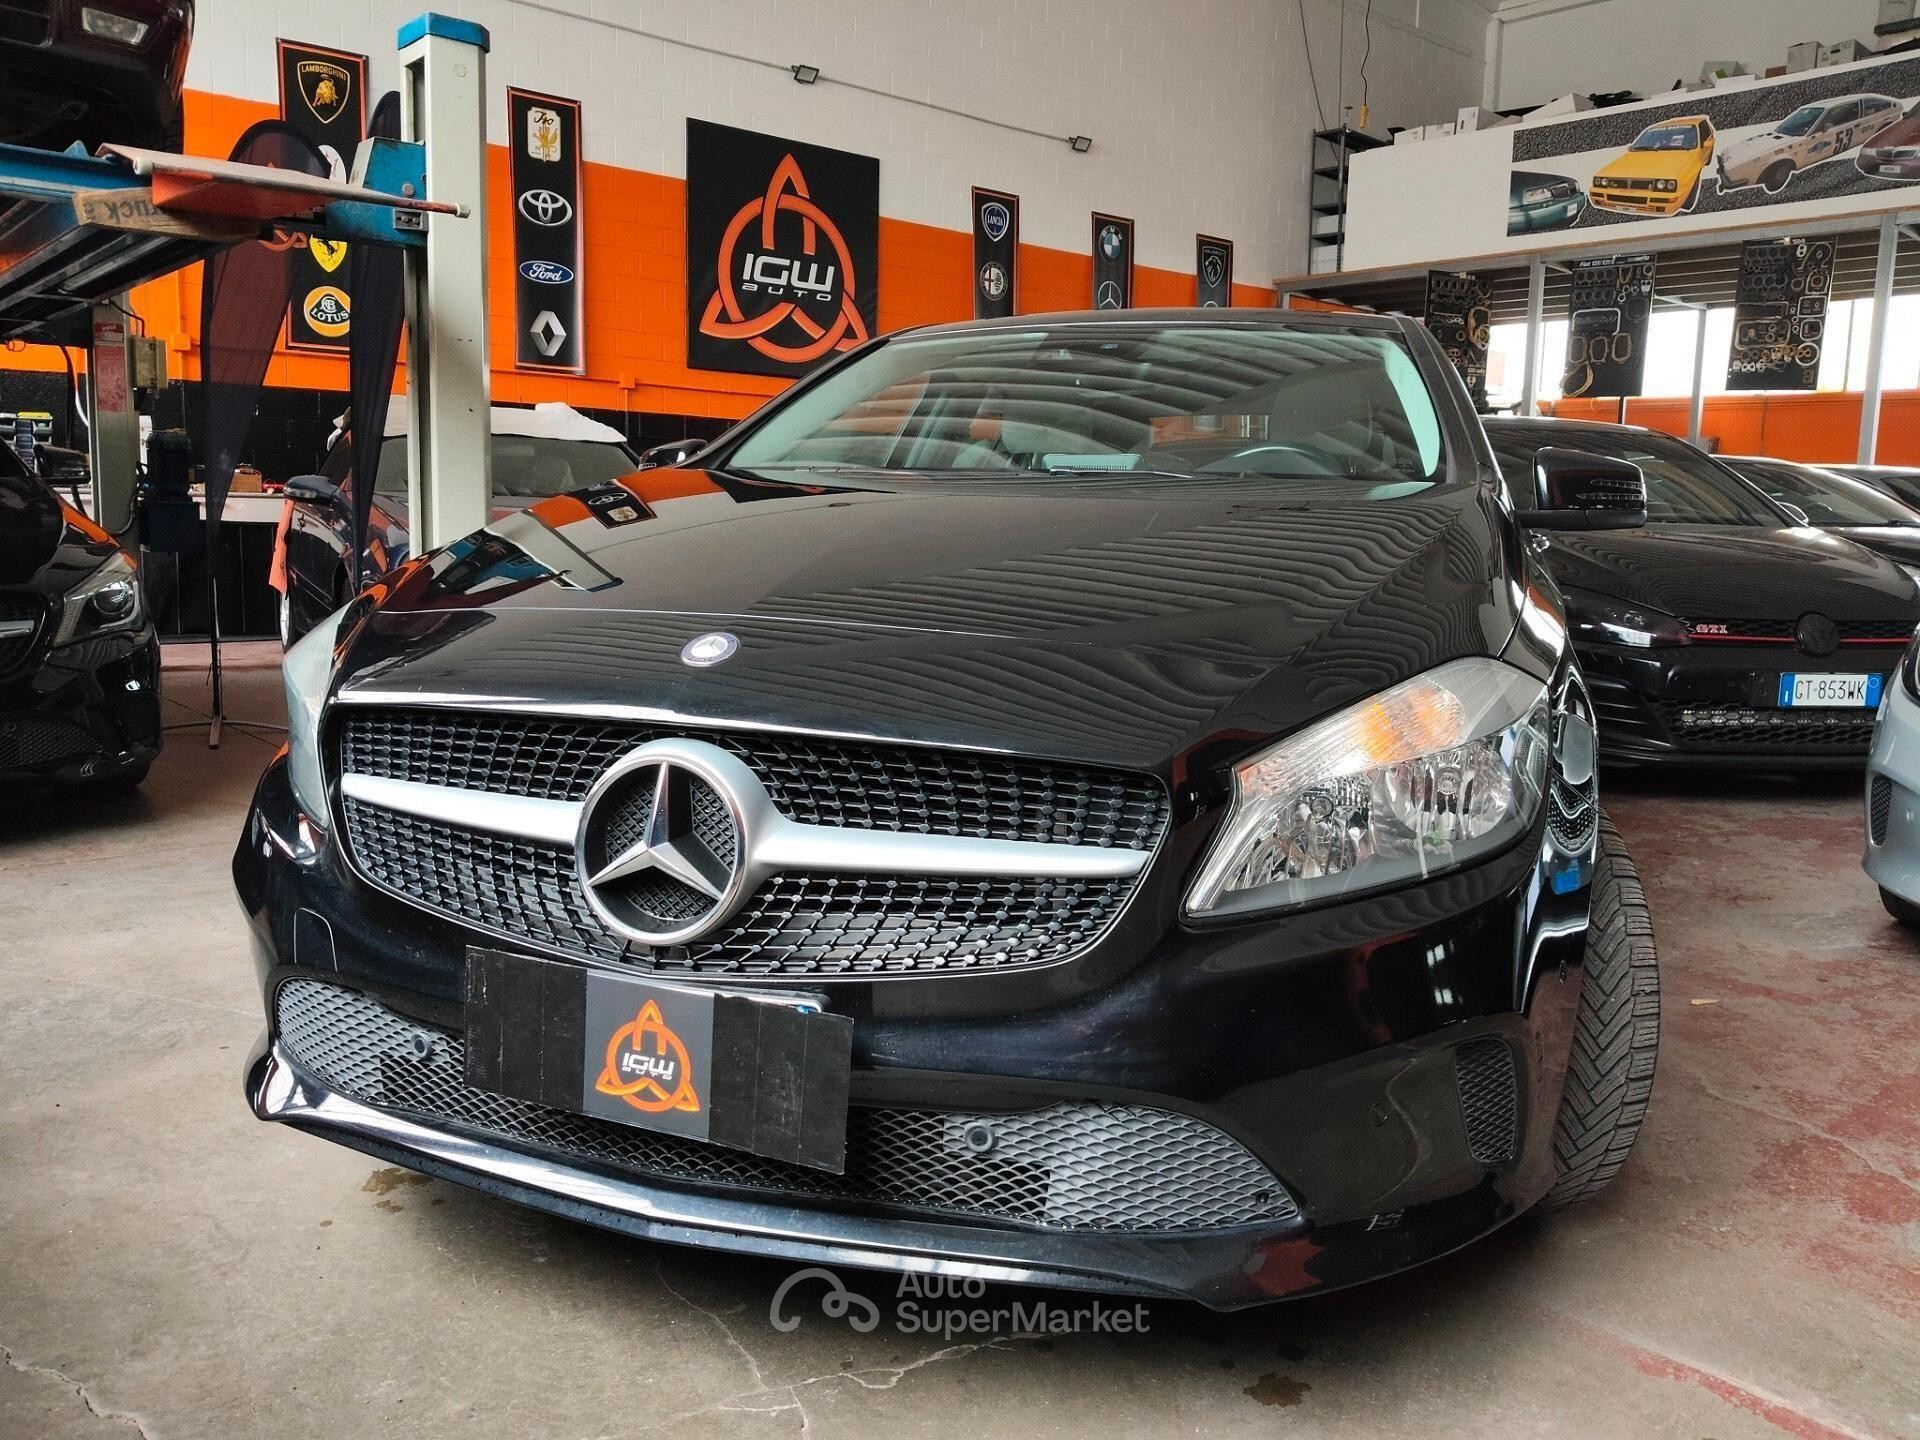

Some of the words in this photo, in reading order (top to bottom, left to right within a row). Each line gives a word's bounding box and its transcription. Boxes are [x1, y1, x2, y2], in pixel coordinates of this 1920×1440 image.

[301, 64, 347, 81] LAMBORGHINI
[529, 263, 563, 281] Ford
[742, 253, 835, 292] IGW
[311, 308, 349, 323] LOTUS
[1695, 623, 1728, 634] GTI
[622, 1052, 675, 1076] IGW
